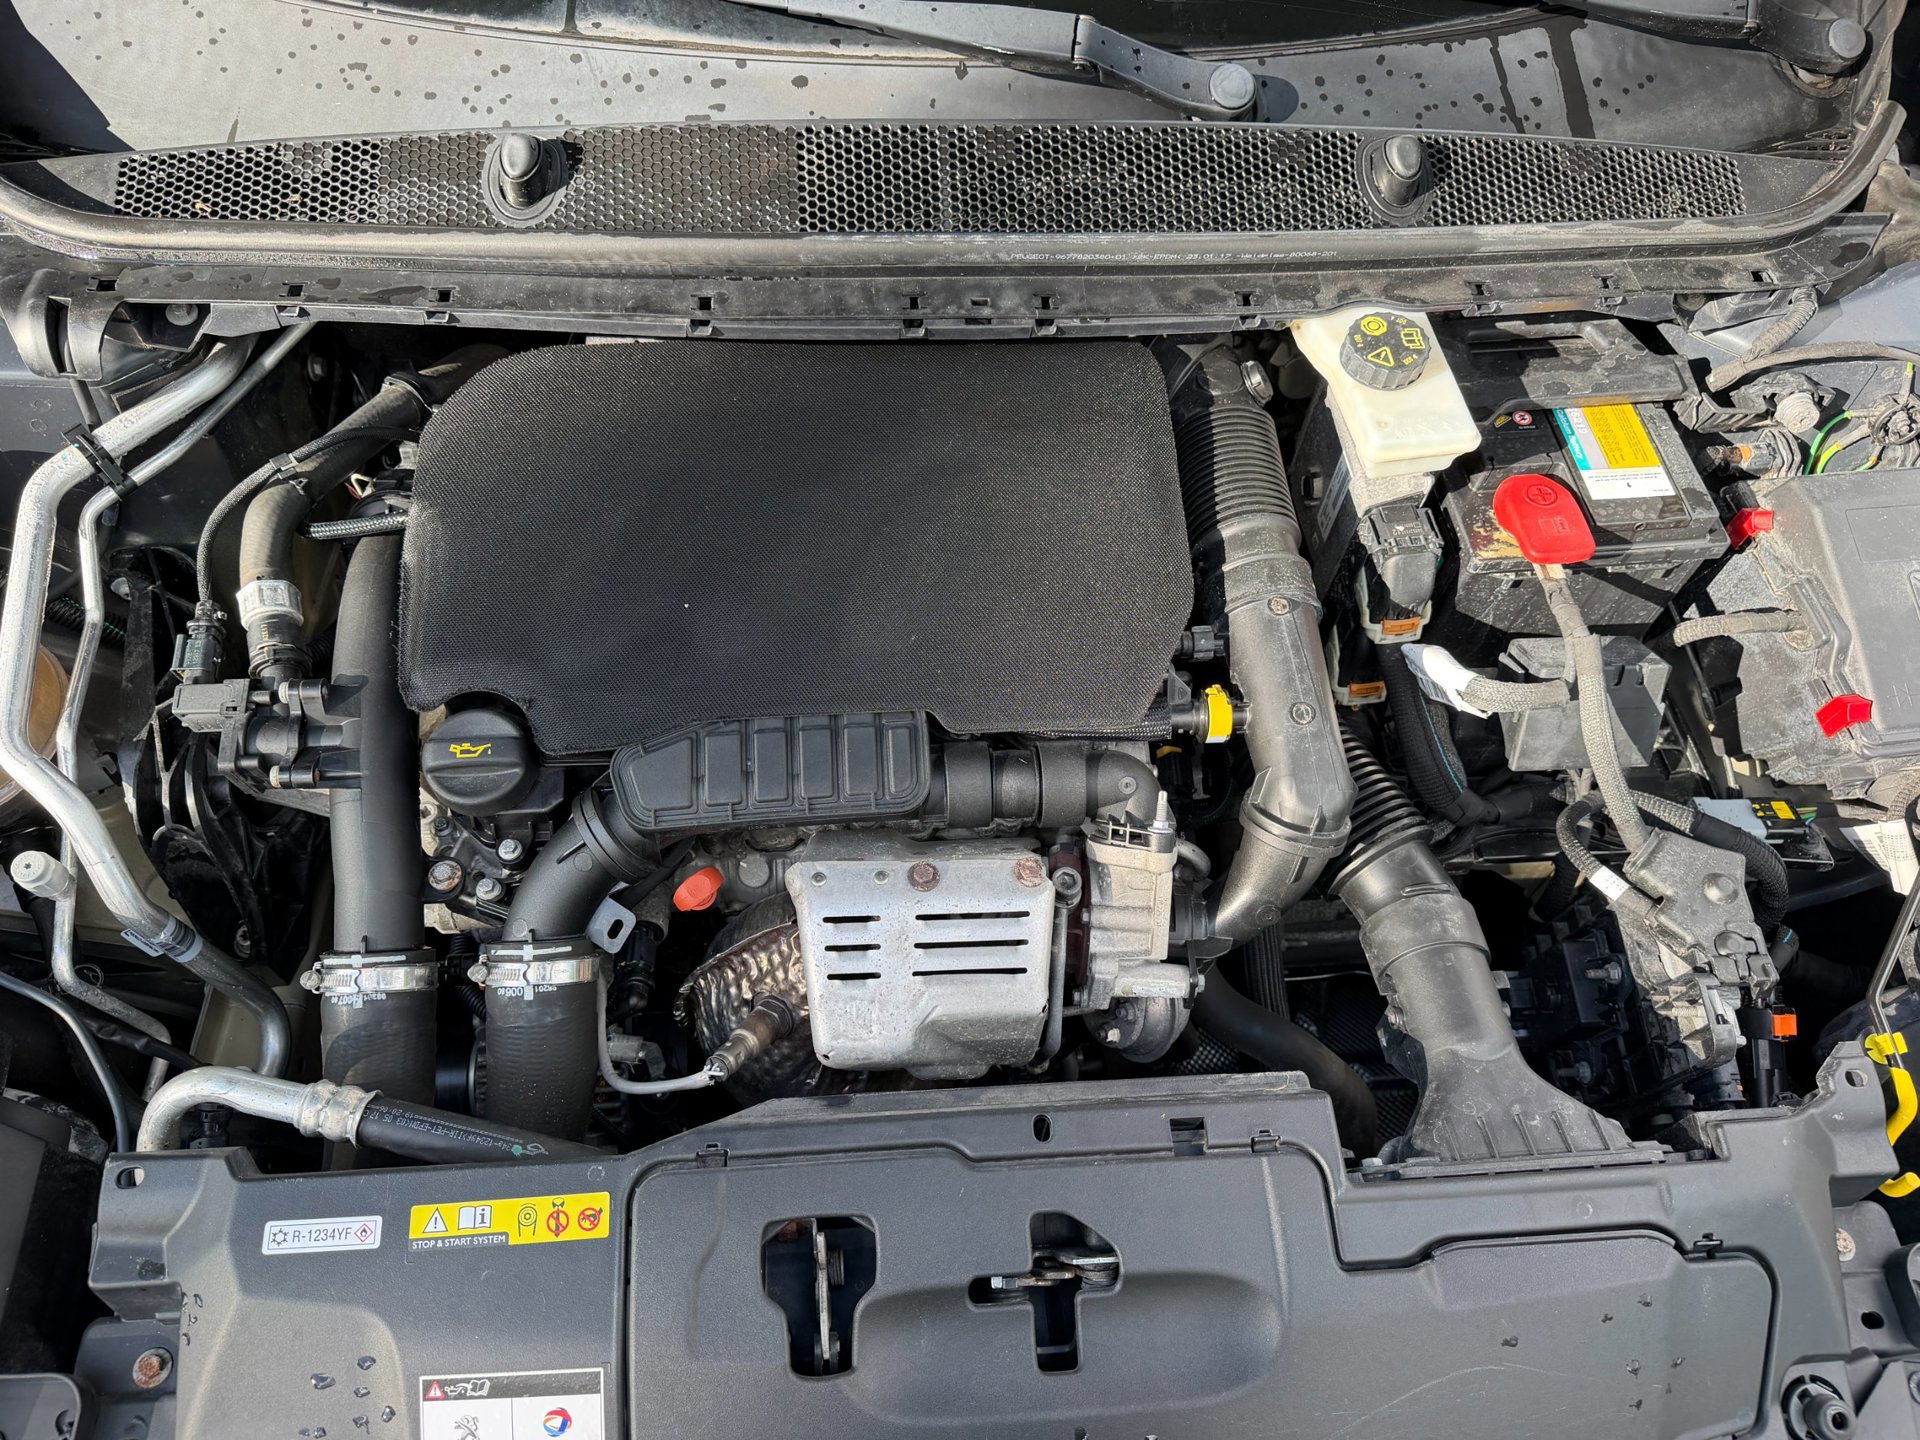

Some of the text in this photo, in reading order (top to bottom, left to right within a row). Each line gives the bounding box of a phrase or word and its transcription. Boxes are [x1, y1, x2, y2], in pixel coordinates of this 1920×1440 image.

[292, 1227, 353, 1243] R-1234YF
[412, 1234, 507, 1249] STOP & START SYSTEM
